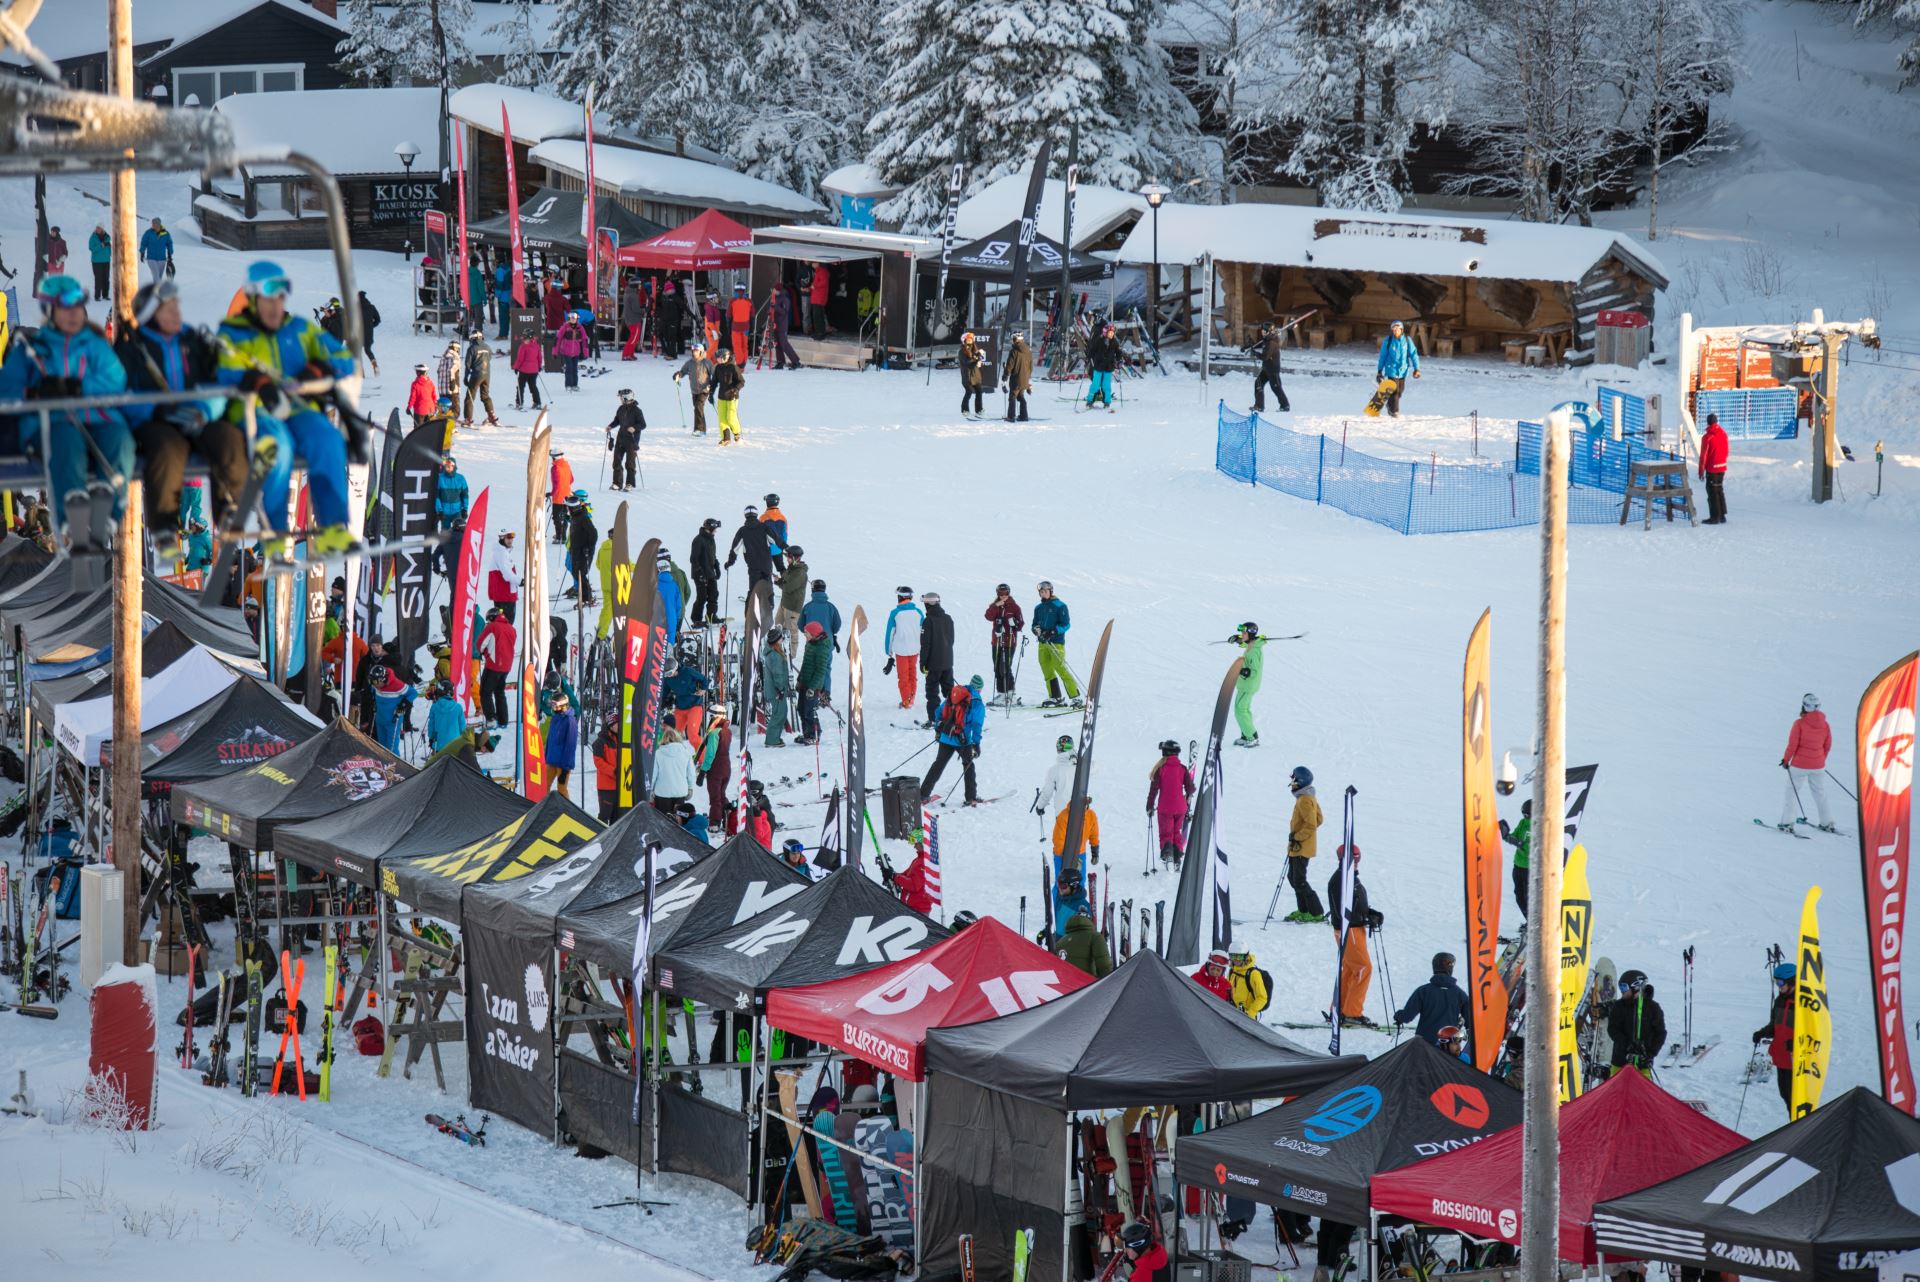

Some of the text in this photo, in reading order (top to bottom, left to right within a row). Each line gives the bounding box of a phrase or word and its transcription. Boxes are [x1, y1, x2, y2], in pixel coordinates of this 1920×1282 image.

[375, 184, 439, 200] KIOSK
[379, 201, 434, 210] HAMBUGARE
[466, 231, 485, 239] COTT
[529, 239, 553, 248] SCOTT
[661, 239, 697, 247] ATOMIC
[960, 256, 1011, 266] salomon
[925, 297, 957, 311] SUNTO
[401, 469, 432, 620] SMITH
[641, 625, 668, 754] STRANDA
[524, 678, 542, 786] LEKI
[835, 916, 928, 965] K2
[481, 982, 518, 1024] I am
[528, 990, 547, 1008] LINE
[485, 1028, 538, 1072] a Skier
[843, 1022, 898, 1066] BURTON
[1274, 1136, 1331, 1157] LANGE
[1227, 1172, 1260, 1186] DYNASTAR
[1292, 1185, 1328, 1203] LANGE
[1432, 1199, 1496, 1227] ROSSIGNOL
[1727, 1245, 1800, 1271] ARMADA
